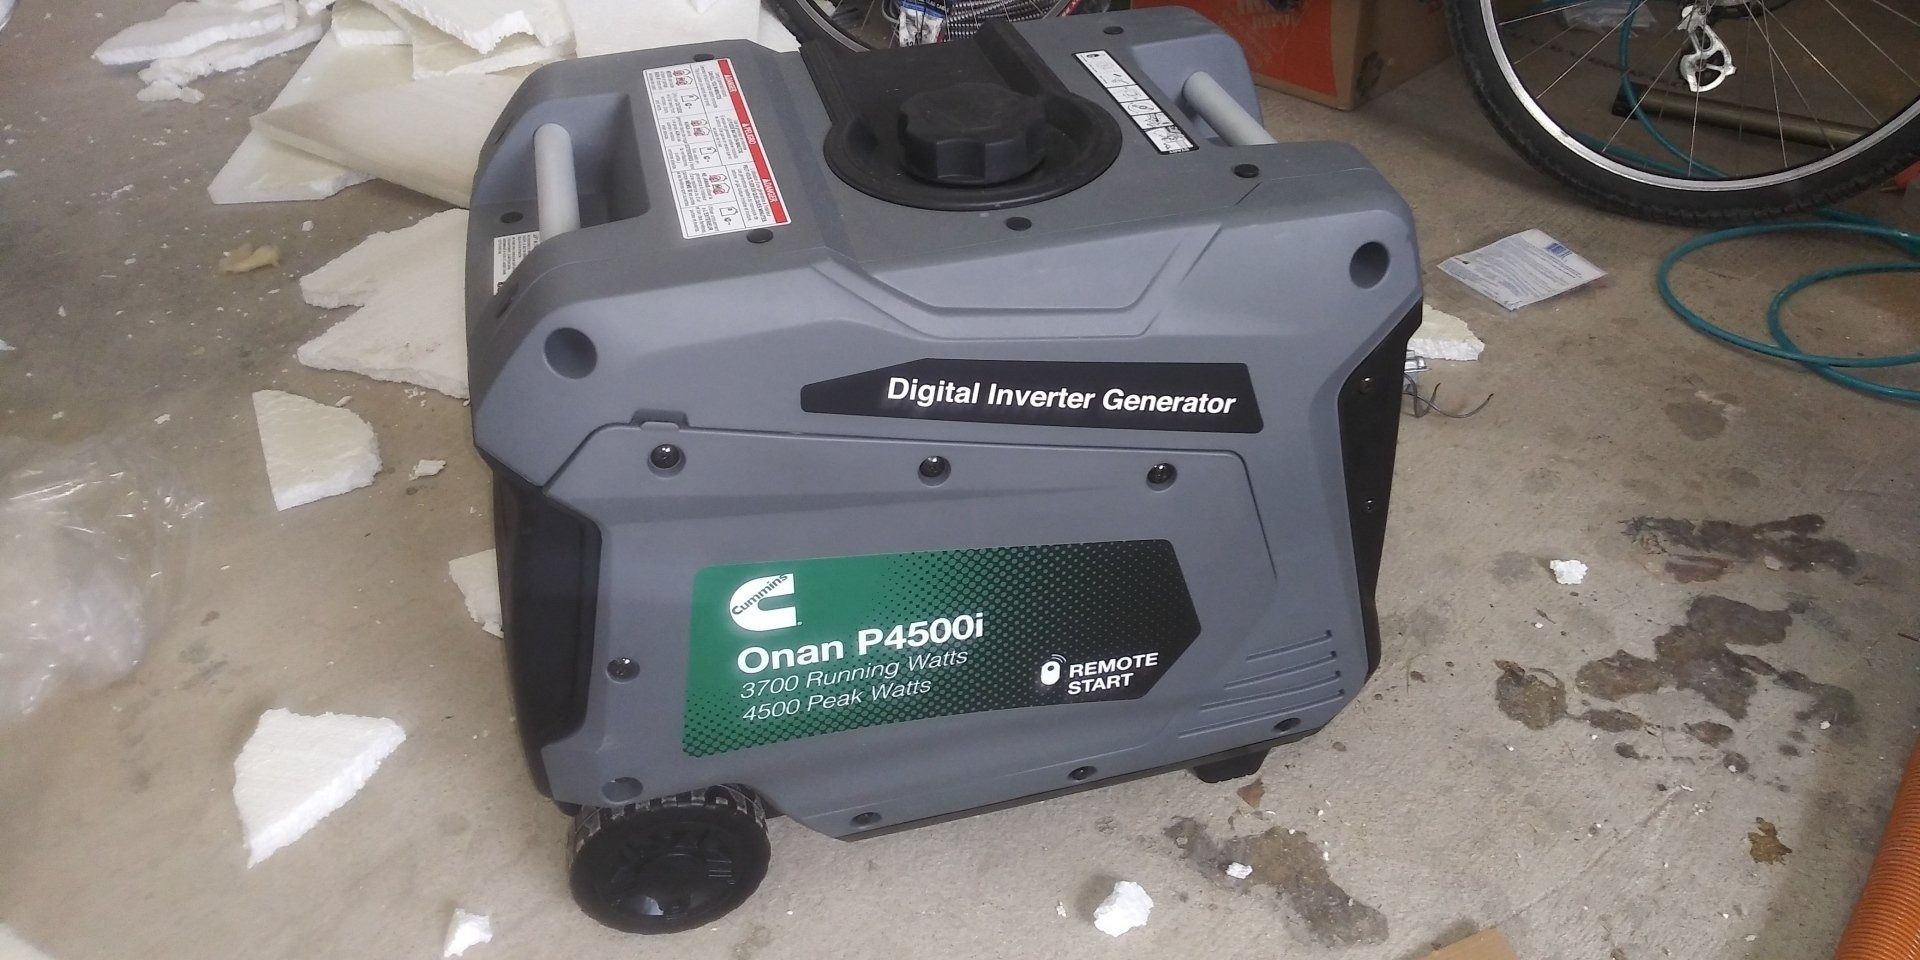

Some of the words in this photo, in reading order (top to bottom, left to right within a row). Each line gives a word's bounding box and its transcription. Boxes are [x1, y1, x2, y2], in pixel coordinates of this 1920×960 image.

[887, 377, 980, 407] Digital
[988, 383, 1097, 409] Inverter
[1102, 387, 1236, 414] Generator
[731, 573, 788, 615] Cummins
[737, 640, 844, 674] Onan
[858, 612, 984, 656] P4500i
[740, 675, 799, 699] 3700
[806, 662, 900, 688] Running
[909, 650, 969, 671] Watts
[1067, 673, 1134, 695] START
[1069, 652, 1159, 678] REMOTE
[742, 699, 801, 721] 4500
[807, 688, 864, 711] Peak
[872, 680, 932, 701] Watts
